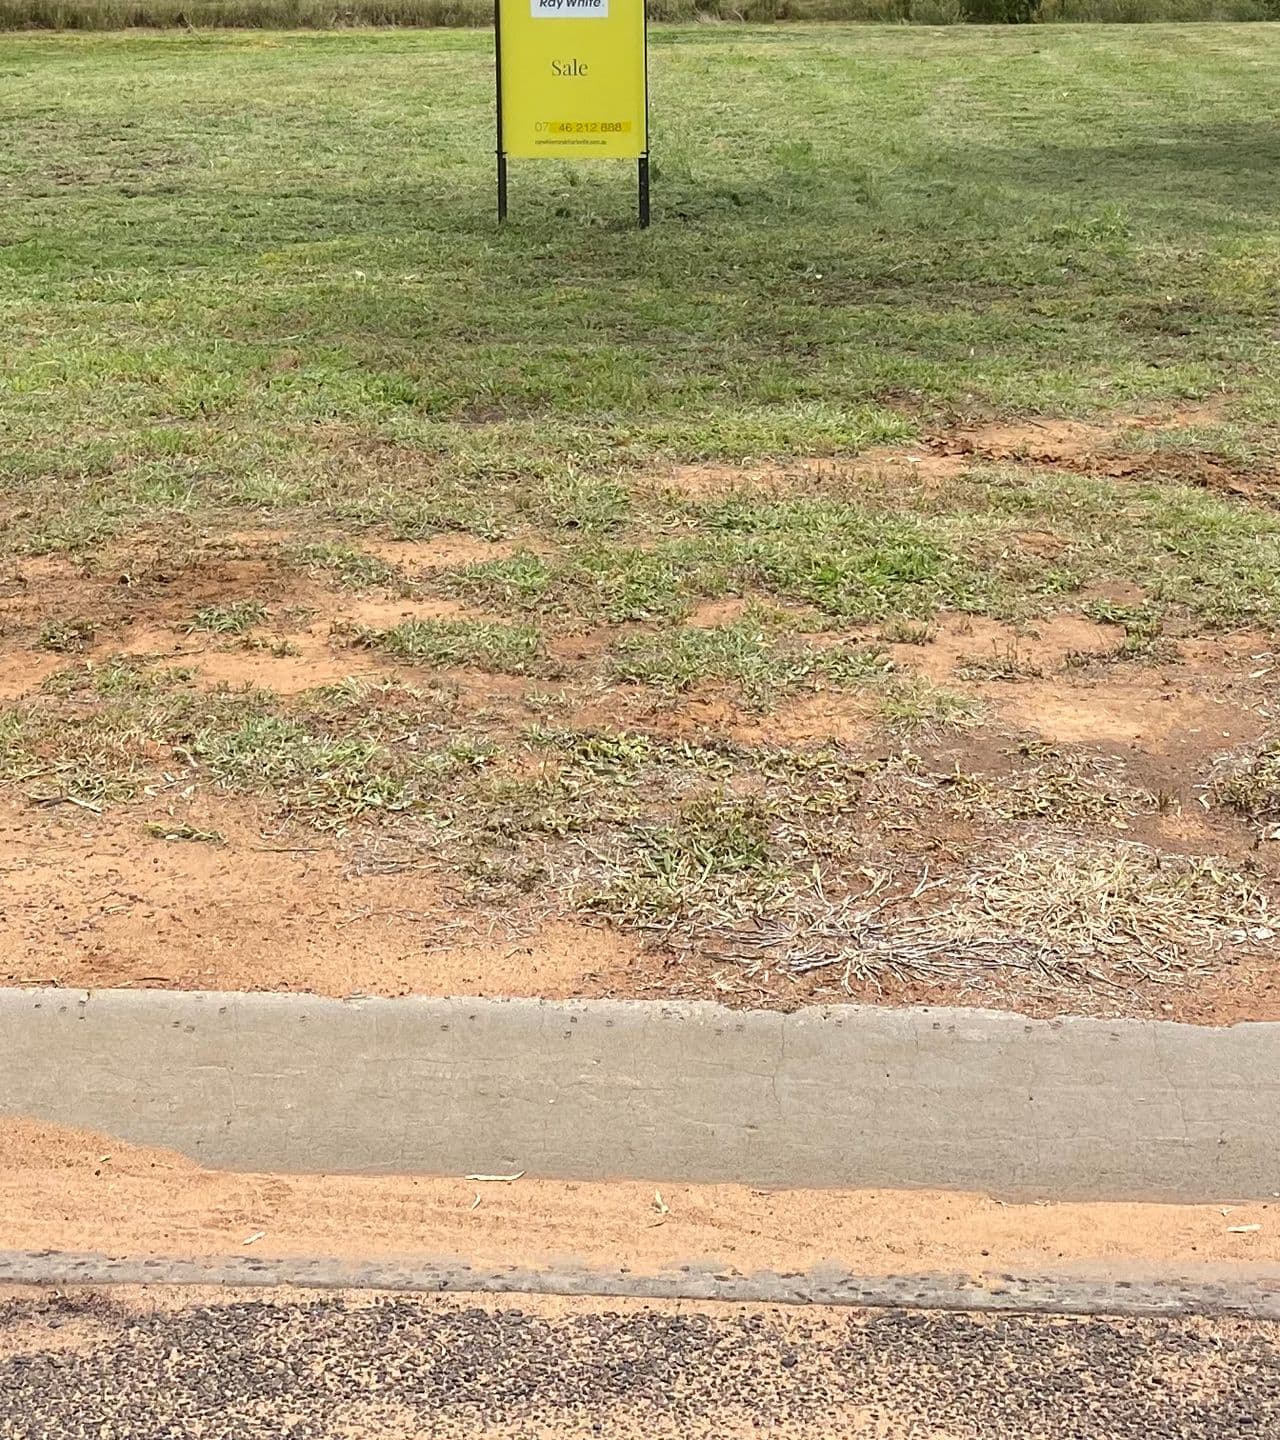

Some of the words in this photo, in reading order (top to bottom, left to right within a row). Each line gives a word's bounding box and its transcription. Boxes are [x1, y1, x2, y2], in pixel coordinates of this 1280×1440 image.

[551, 59, 588, 77] Sale
[534, 121, 549, 132] 07
[559, 122, 573, 133] 46
[575, 122, 598, 133] 212
